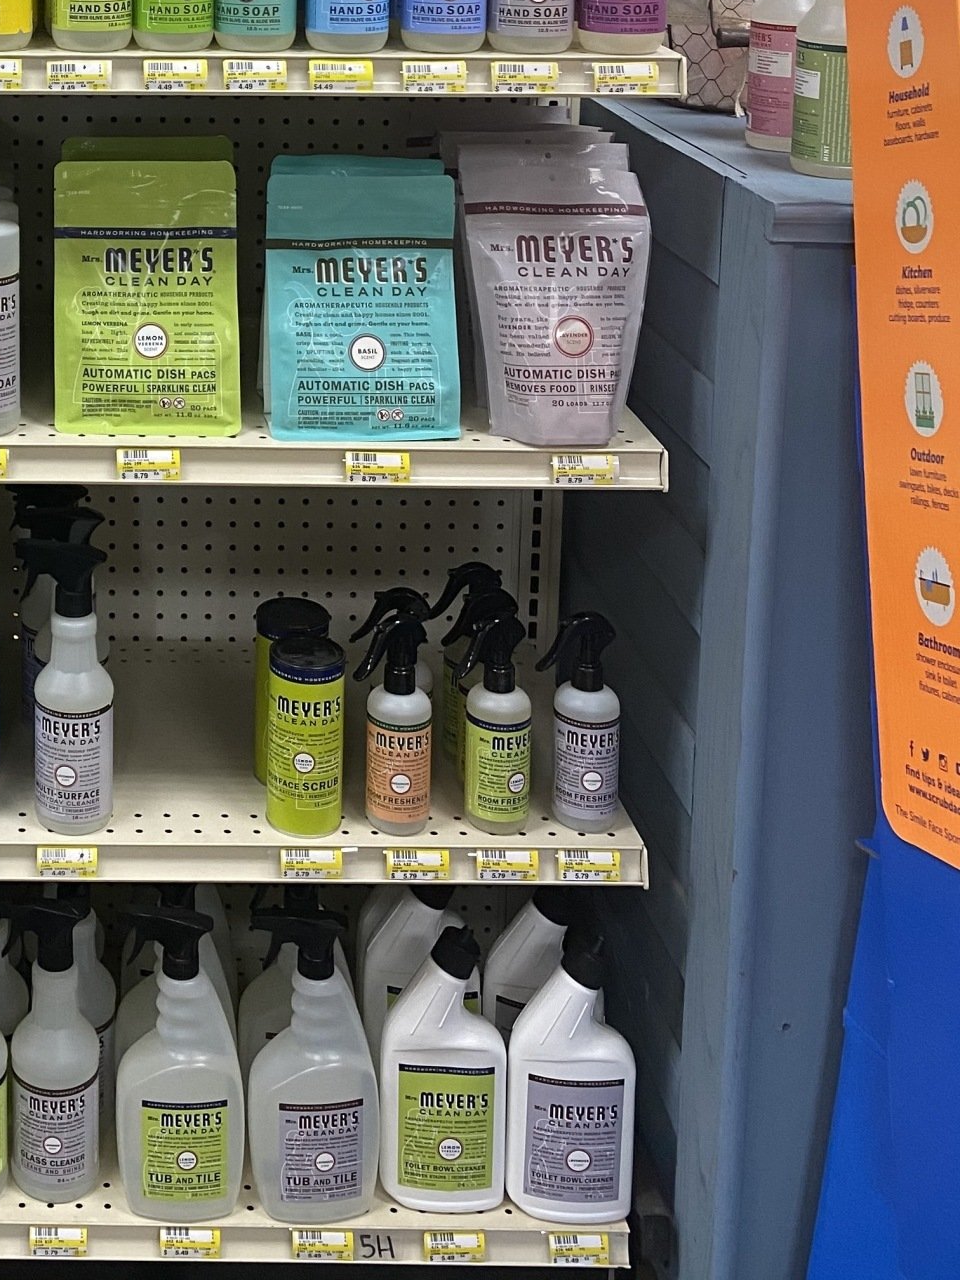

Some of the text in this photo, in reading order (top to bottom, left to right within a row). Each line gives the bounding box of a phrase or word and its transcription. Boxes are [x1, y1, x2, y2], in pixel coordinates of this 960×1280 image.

[413, 5, 480, 15] HAND SOAP
[889, 83, 930, 104] Household
[516, 235, 634, 264] MEYER'S
[82, 247, 216, 274] Mrs. MEYER'S
[316, 257, 430, 285] MEYER'S
[518, 267, 630, 277] CLEAN DAY
[902, 266, 933, 280] Kitchen
[106, 277, 213, 286] CLEAN DAY
[317, 287, 427, 296] CLEAN DAY
[83, 368, 152, 379] AUTOMATIC
[158, 369, 186, 378] DISH
[82, 384, 216, 393] POWERFUL SPARKLING CLEAN
[298, 380, 434, 391] AUTOMATIC DISH PACS
[911, 448, 944, 464] Outdoor
[134, 472, 148, 480] 8.79
[918, 632, 960, 659] Bathroom
[42, 719, 100, 736] MEYER'S
[906, 764, 920, 780] find
[922, 773, 935, 788] tips
[302, 777, 338, 791] SCRUB
[420, 1092, 488, 1109] MEYER'S
[161, 1113, 222, 1128] MEYER'S
[406, 1163, 485, 1173] TOILET BOWL CLEANER
[149, 1174, 172, 1183] TUB
[196, 1173, 221, 1181] TILE
[360, 1234, 393, 1259] 5H
